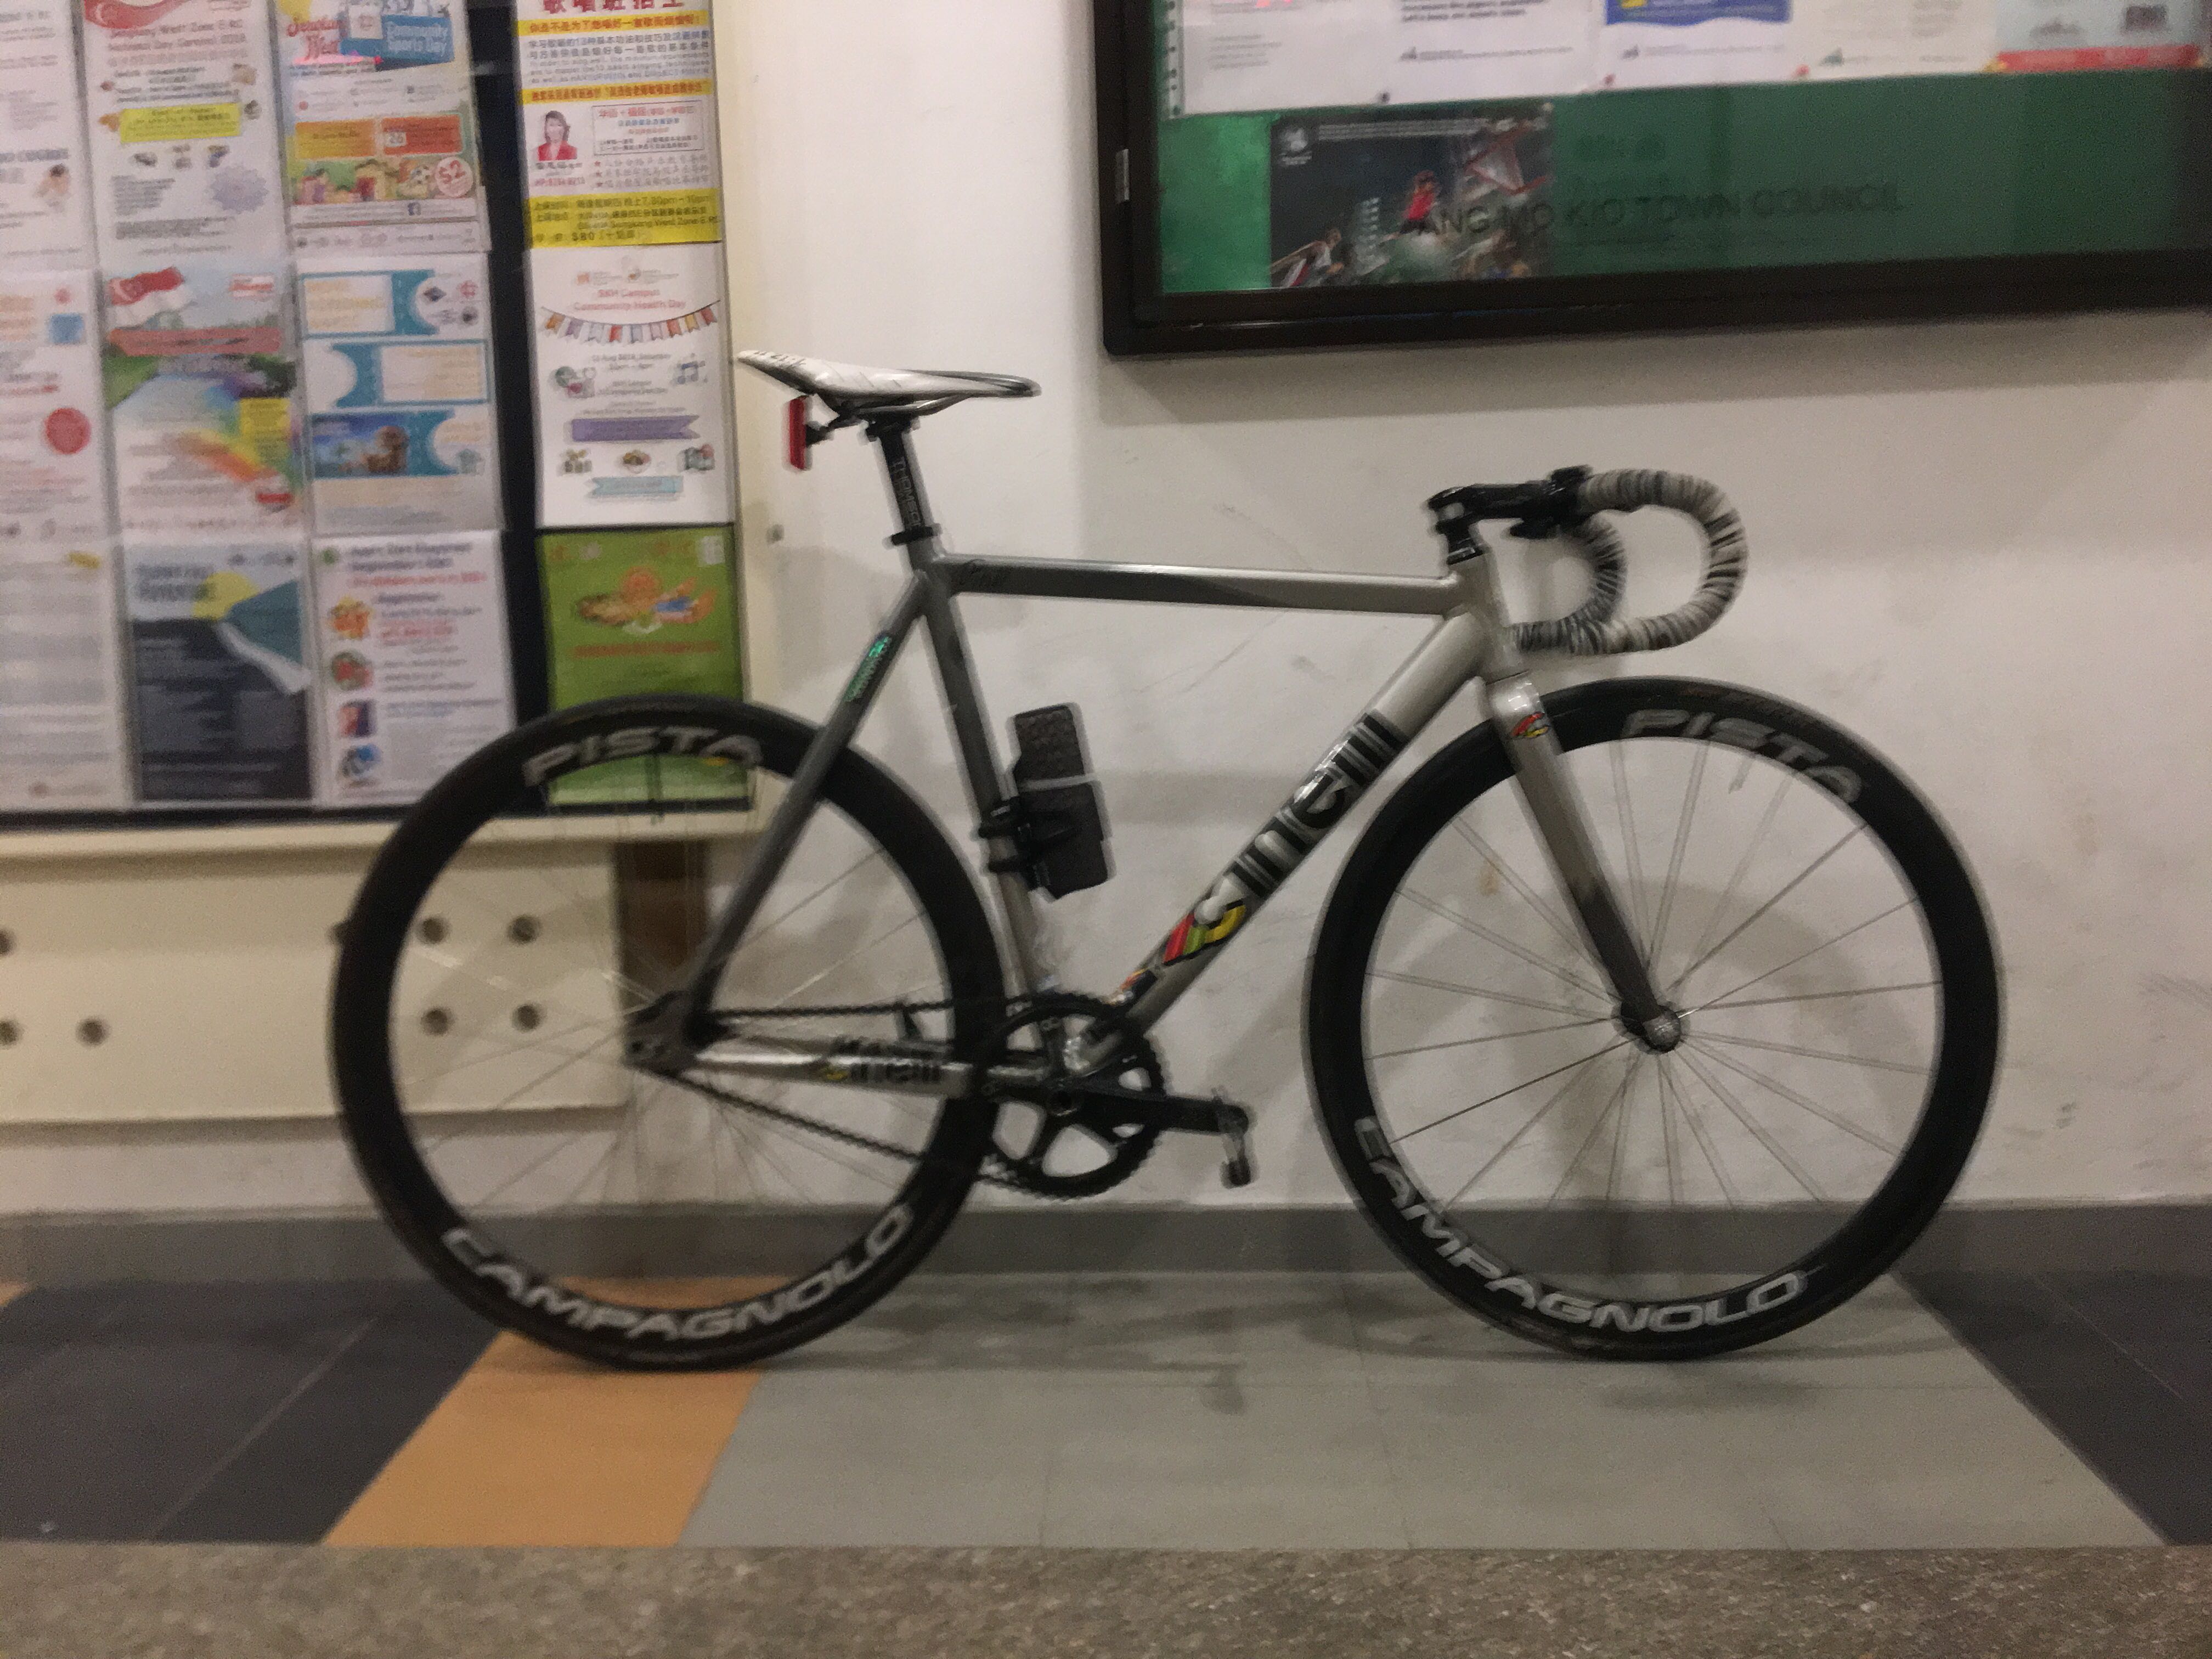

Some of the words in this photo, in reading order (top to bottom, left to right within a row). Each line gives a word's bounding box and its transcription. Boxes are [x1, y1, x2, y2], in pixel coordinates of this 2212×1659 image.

[521, 725, 764, 787] PISTA
[1620, 709, 1863, 804] PISTA
[442, 1204, 913, 1341] CAMPAGNOLO
[1353, 1115, 1810, 1333] CAMPAGNOLO
